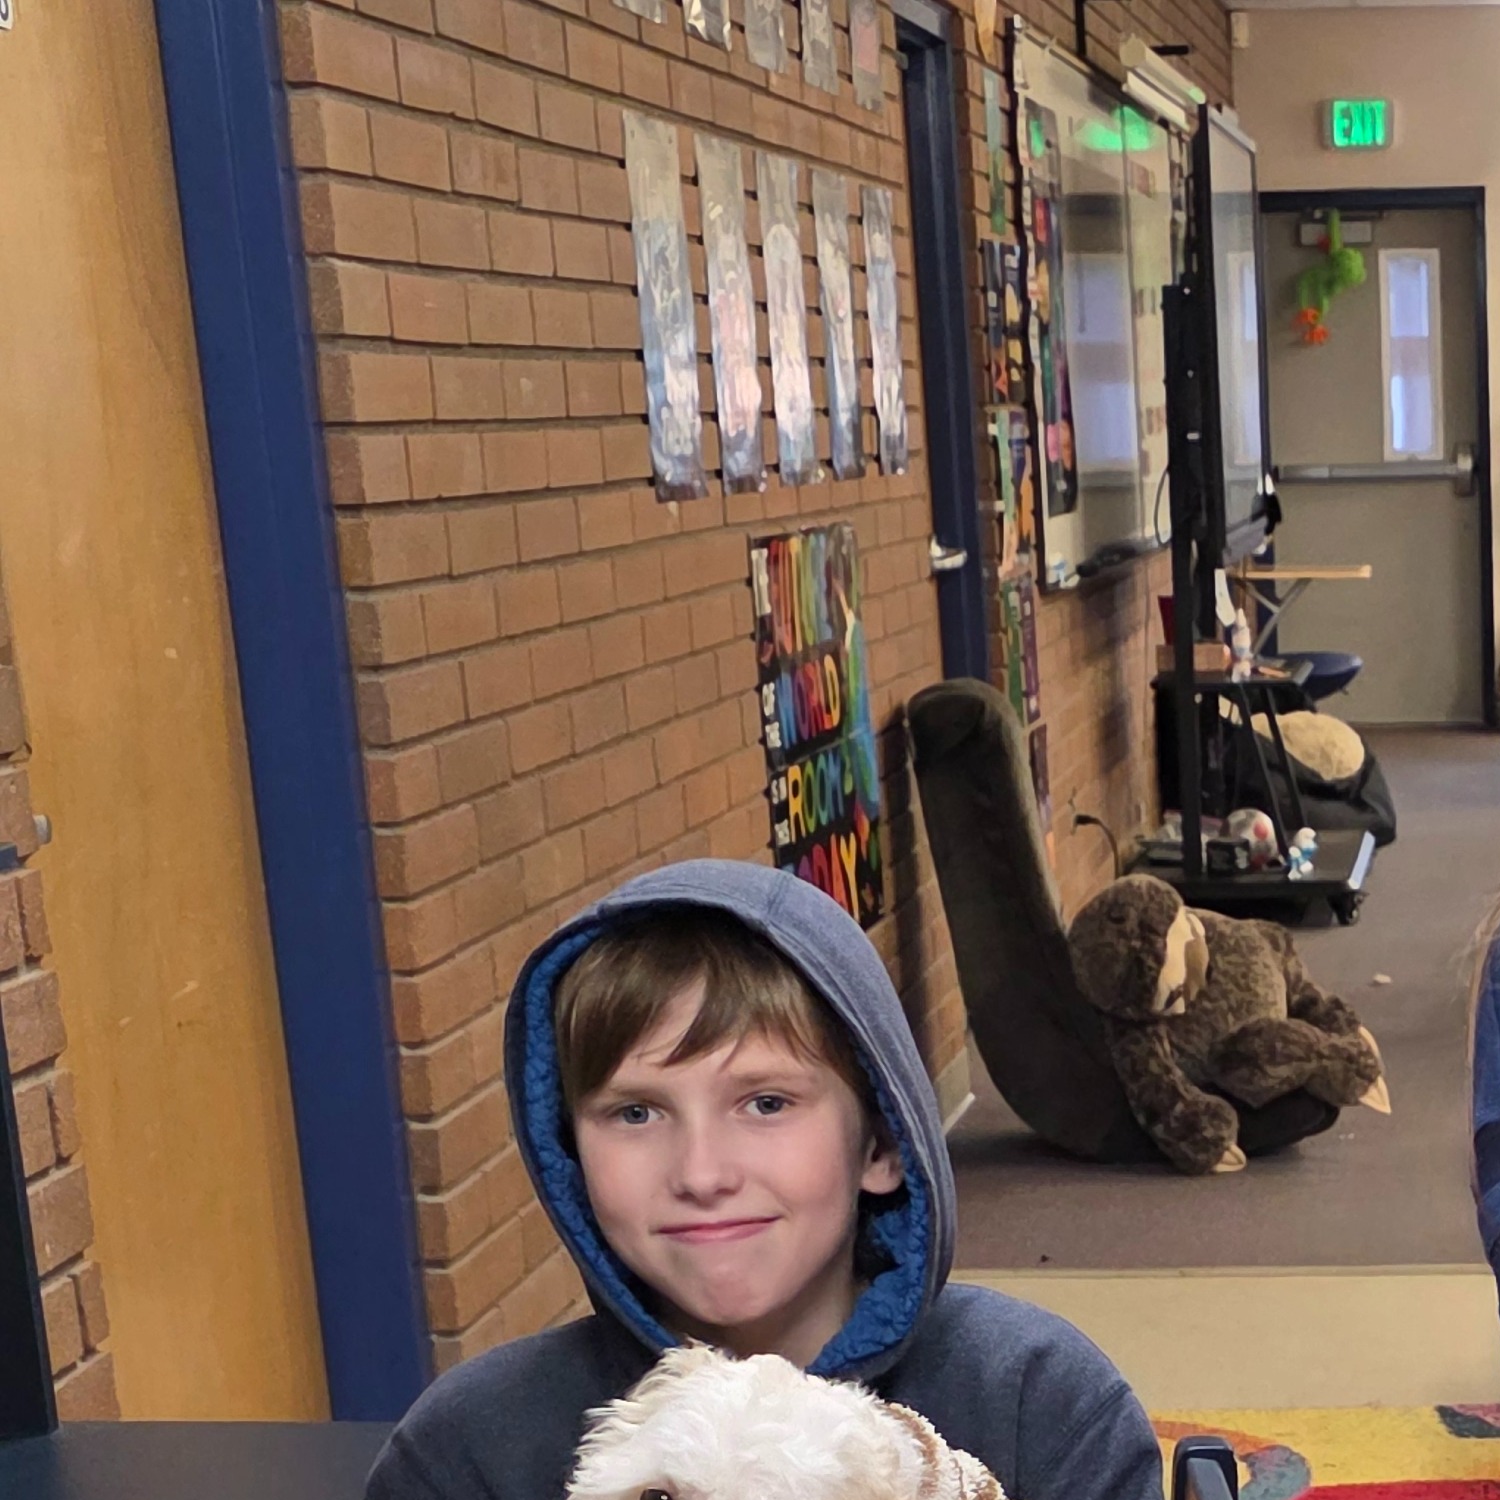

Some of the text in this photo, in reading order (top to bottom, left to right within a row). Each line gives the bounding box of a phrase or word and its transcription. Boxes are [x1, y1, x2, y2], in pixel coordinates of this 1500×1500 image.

[1334, 101, 1385, 146] EXIT
[775, 654, 841, 750] WORLD
[788, 751, 845, 844] ROOM
